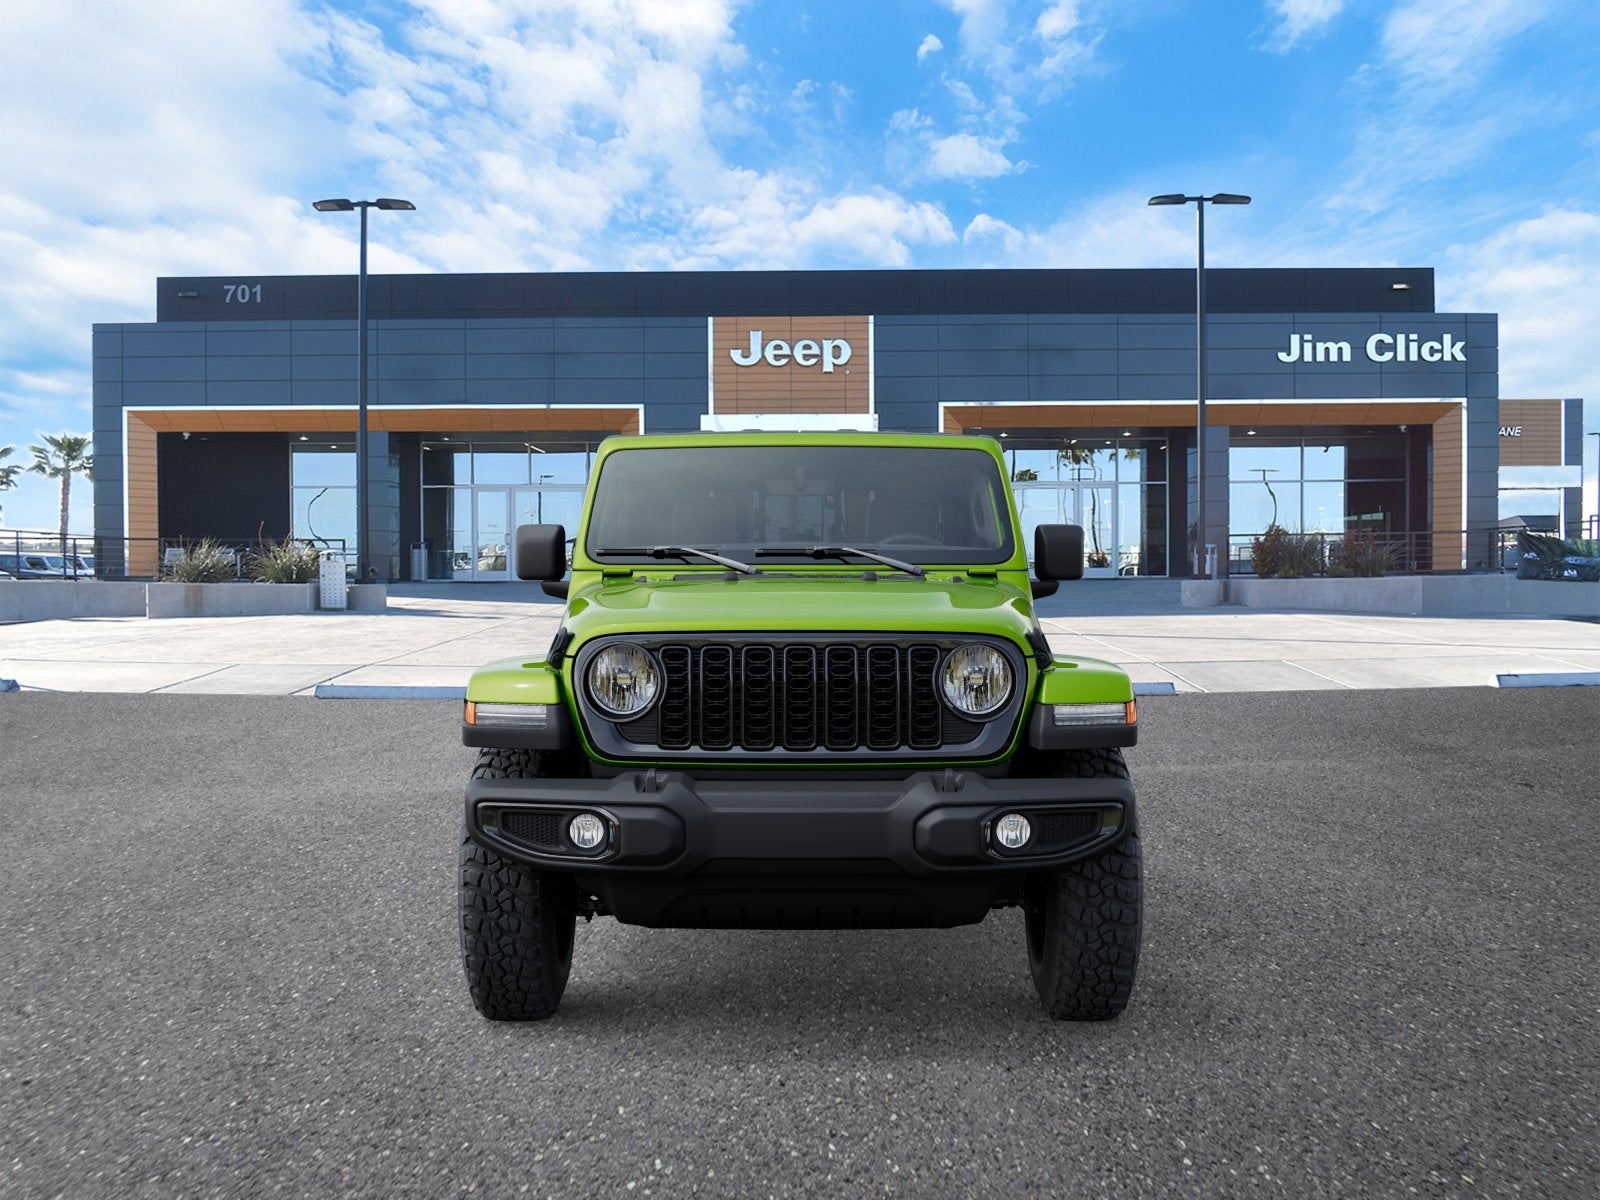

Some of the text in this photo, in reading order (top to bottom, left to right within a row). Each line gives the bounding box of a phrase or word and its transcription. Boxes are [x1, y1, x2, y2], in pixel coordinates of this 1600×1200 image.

[223, 284, 262, 304] 701
[729, 330, 852, 373] Jeep
[1277, 333, 1467, 363] Jim Click
